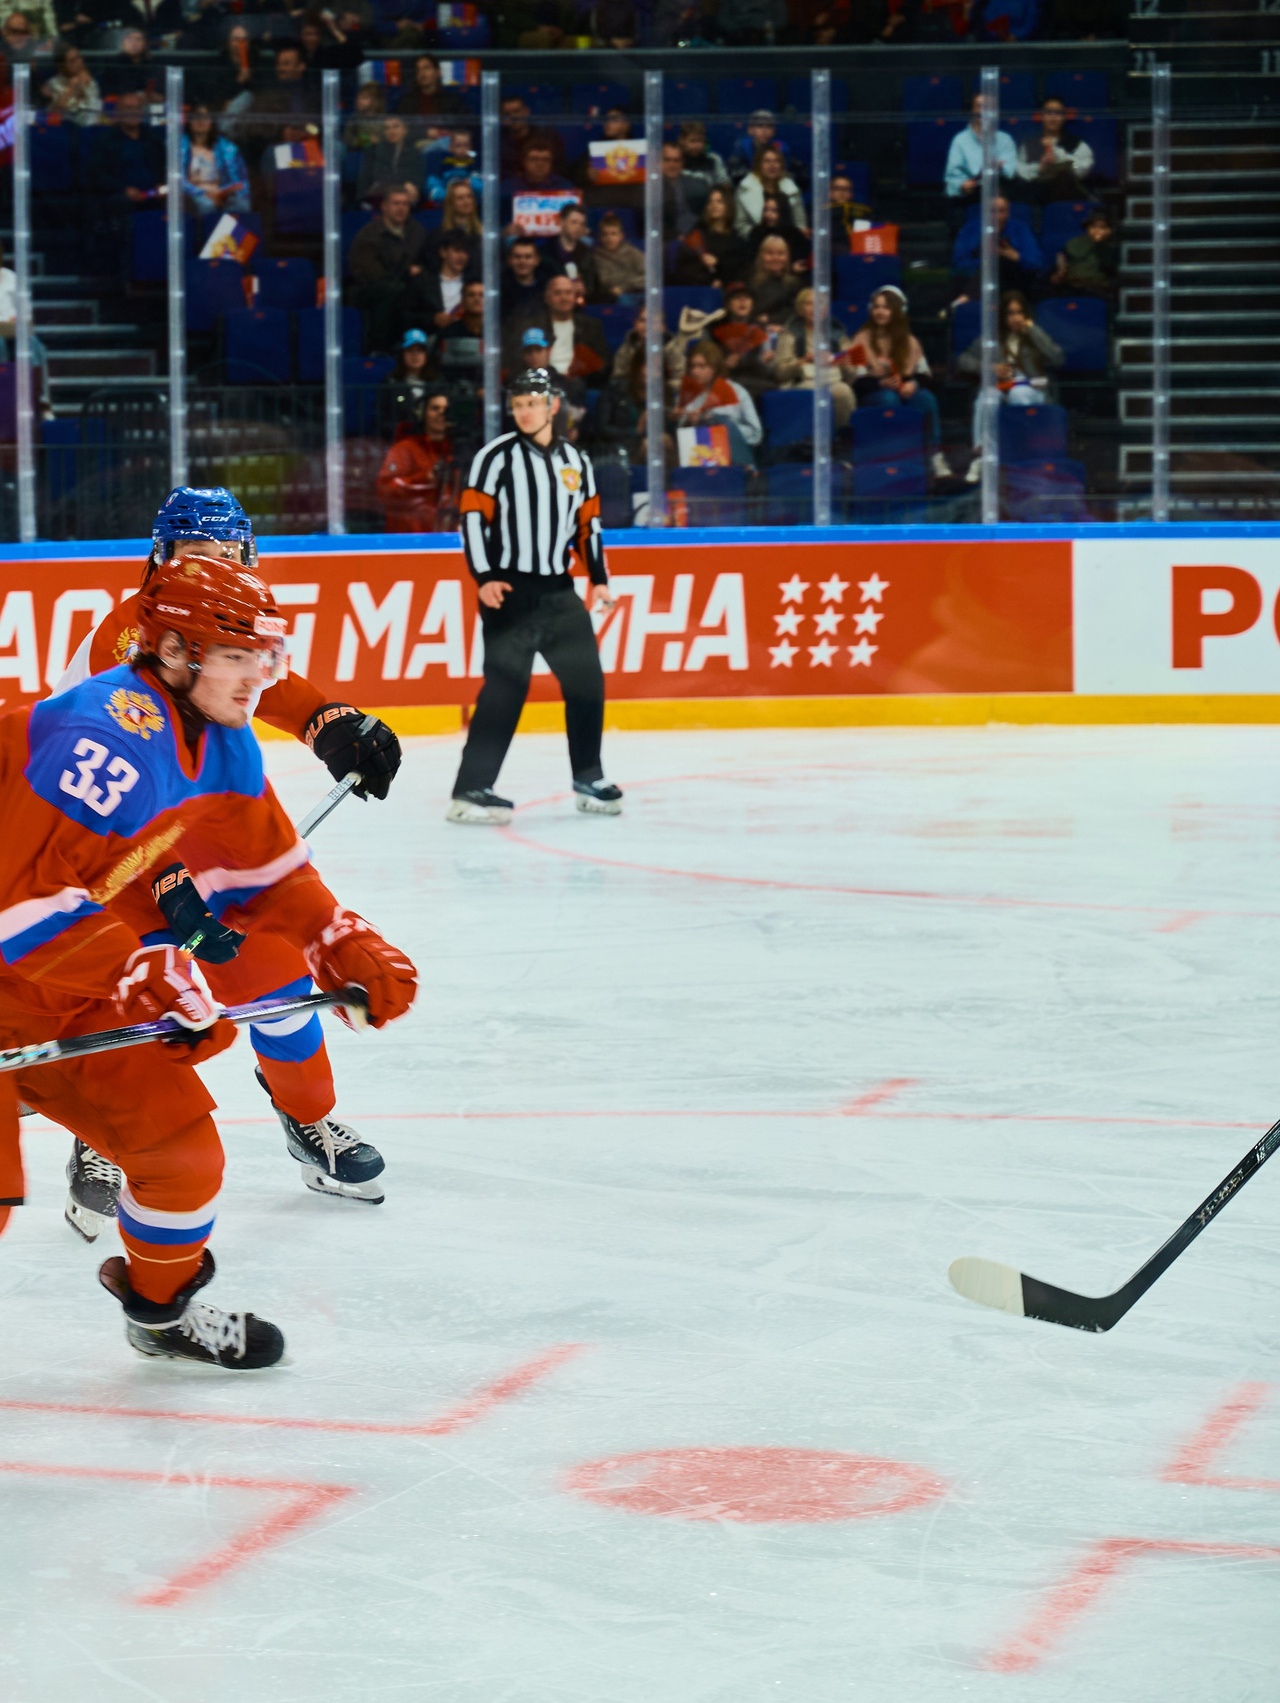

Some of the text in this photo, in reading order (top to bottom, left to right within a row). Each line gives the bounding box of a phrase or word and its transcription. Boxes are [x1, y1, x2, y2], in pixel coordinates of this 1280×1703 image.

[201, 515, 230, 523] CCM
[59, 737, 140, 817] 33
[329, 777, 352, 801] HIT
